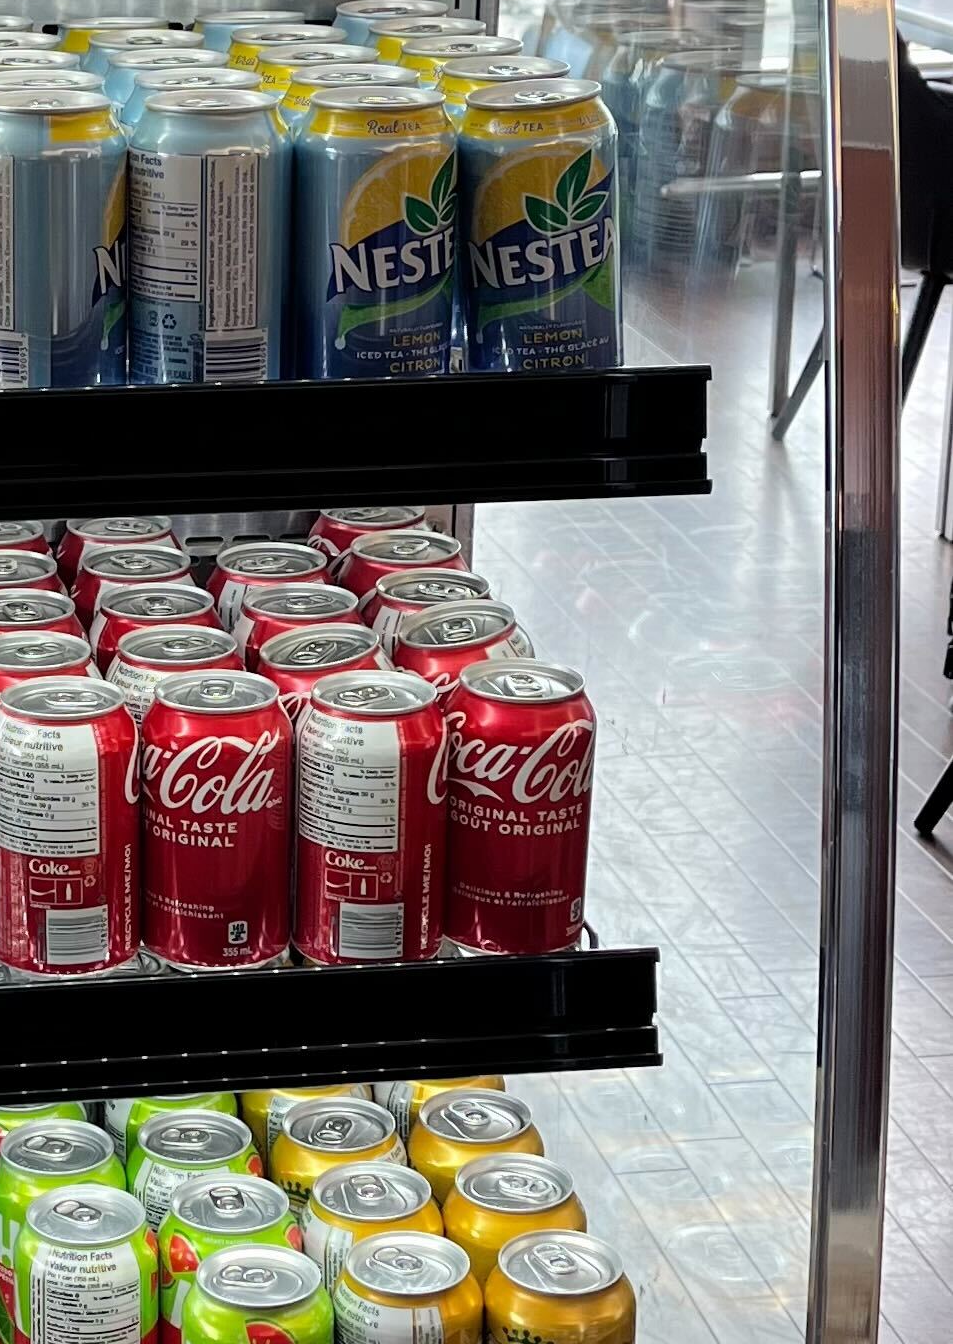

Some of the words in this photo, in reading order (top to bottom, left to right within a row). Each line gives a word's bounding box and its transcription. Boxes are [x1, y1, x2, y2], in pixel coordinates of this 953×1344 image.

[367, 120, 399, 135] Real
[522, 123, 544, 132] TEA
[140, 155, 163, 167] Facts
[329, 226, 454, 294] NESTE
[467, 217, 617, 289] NESTEA
[393, 330, 441, 347] LEMON
[524, 329, 583, 345] LEMON
[357, 350, 381, 360] ICED
[384, 350, 403, 359] TEA
[516, 346, 536, 355] TEA
[545, 342, 565, 353] THÉ
[390, 356, 441, 374] CITRON
[523, 354, 586, 370] CITRON
[23, 742, 64, 752] nutritive
[449, 794, 530, 823] ORIGINAL
[537, 803, 583, 823] TASTE
[180, 819, 238, 834] TASTE
[450, 809, 492, 832] GOÛT
[499, 819, 581, 837] ORIGINAL
[153, 824, 235, 847] ORIGINAL
[28, 858, 71, 875] Coke
[325, 850, 365, 869] Coke
[123, 844, 132, 895] ME/MOI
[422, 843, 433, 893] ME/MOI
[513, 889, 564, 901] Refreshing
[165, 897, 215, 912] Refreshing
[223, 948, 244, 957] 355
[52, 1249, 88, 1262] Nutrition
[90, 1250, 114, 1261] Facts
[79, 1263, 117, 1273] nutritive
[358, 1300, 381, 1317] Facts
